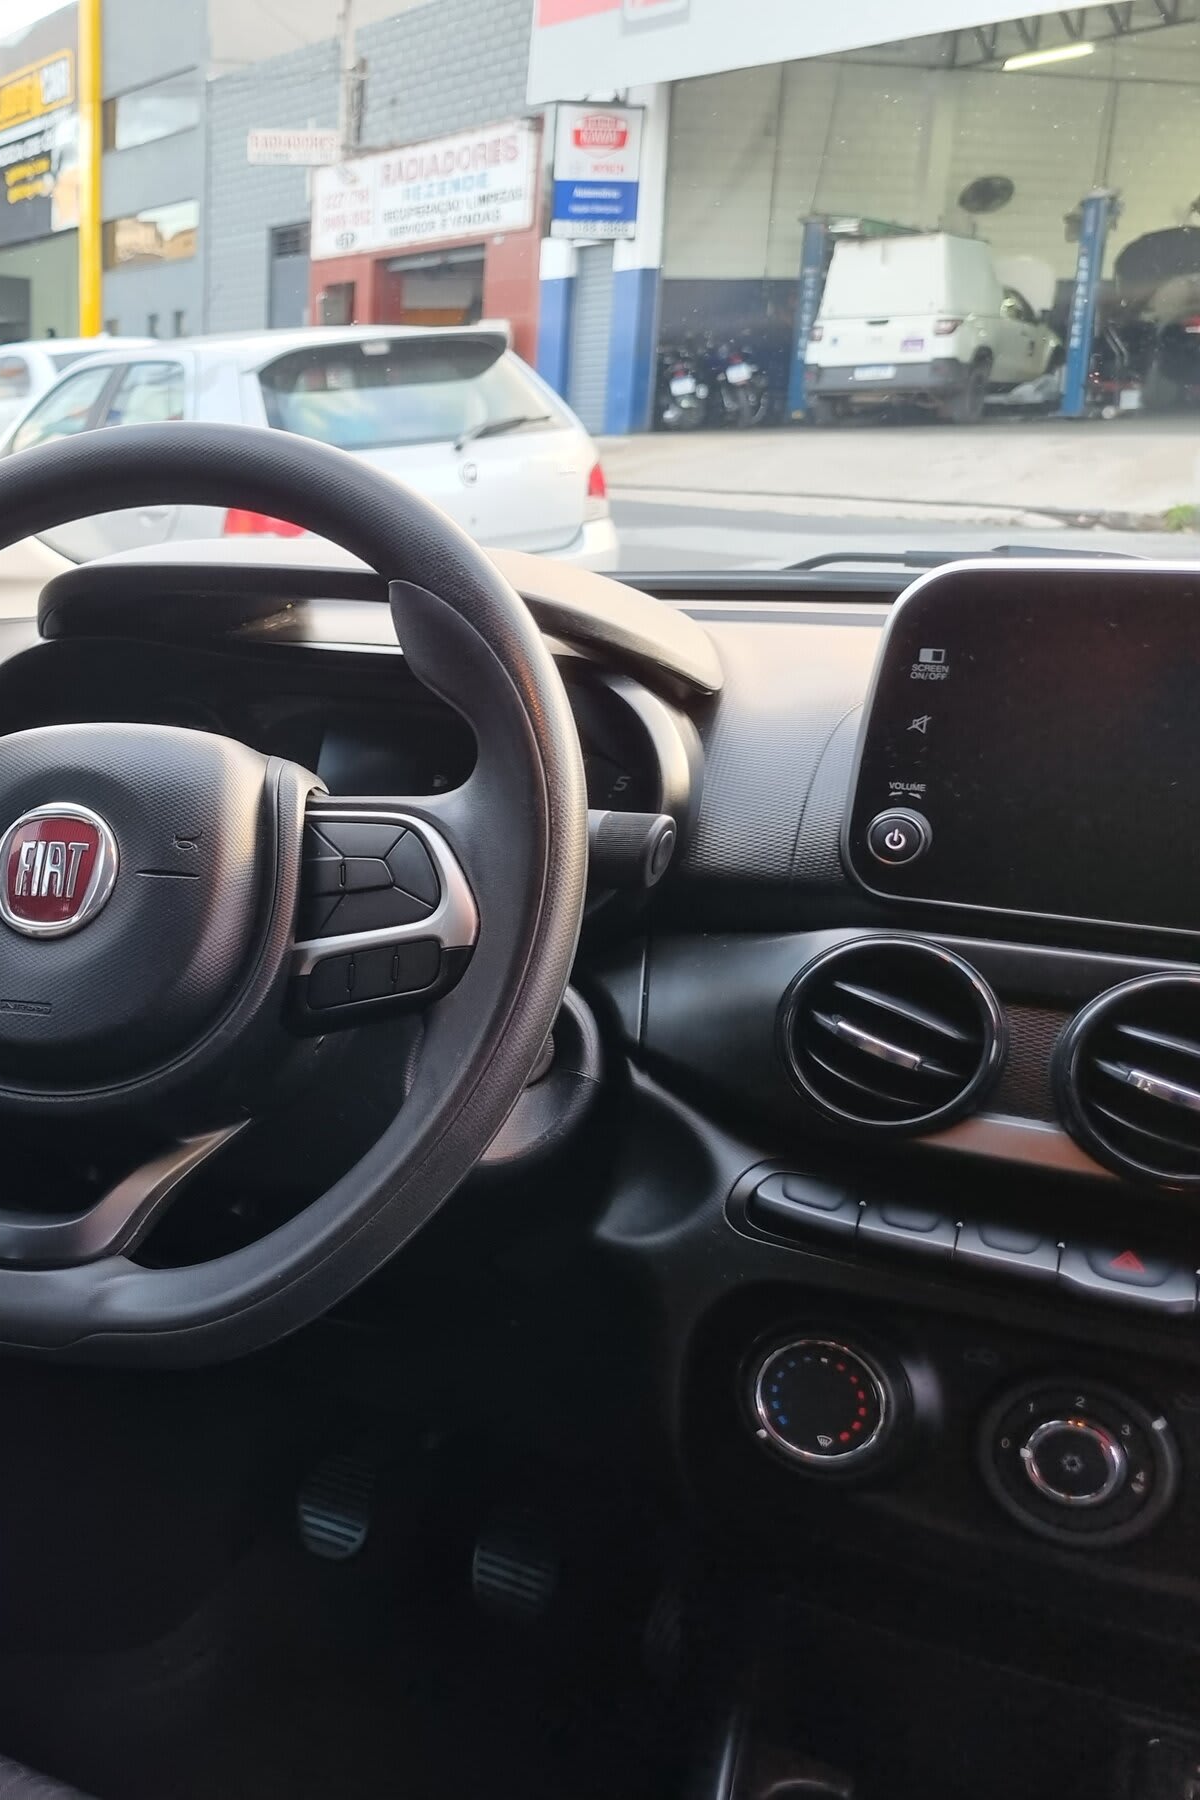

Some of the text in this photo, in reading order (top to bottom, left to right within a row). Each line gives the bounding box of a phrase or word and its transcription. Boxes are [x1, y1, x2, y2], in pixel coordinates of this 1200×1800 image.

[382, 134, 520, 188] RADIADORES
[911, 663, 950, 673] SCREEN
[910, 671, 948, 681] ON/OFF
[613, 776, 632, 792] 5
[888, 781, 927, 792] VOLUME
[14, 840, 90, 899] FIAT
[1027, 1402, 1034, 1413] 1
[1075, 1396, 1085, 1409] 2
[1120, 1424, 1131, 1436] 3
[1135, 1471, 1145, 1482] 4
